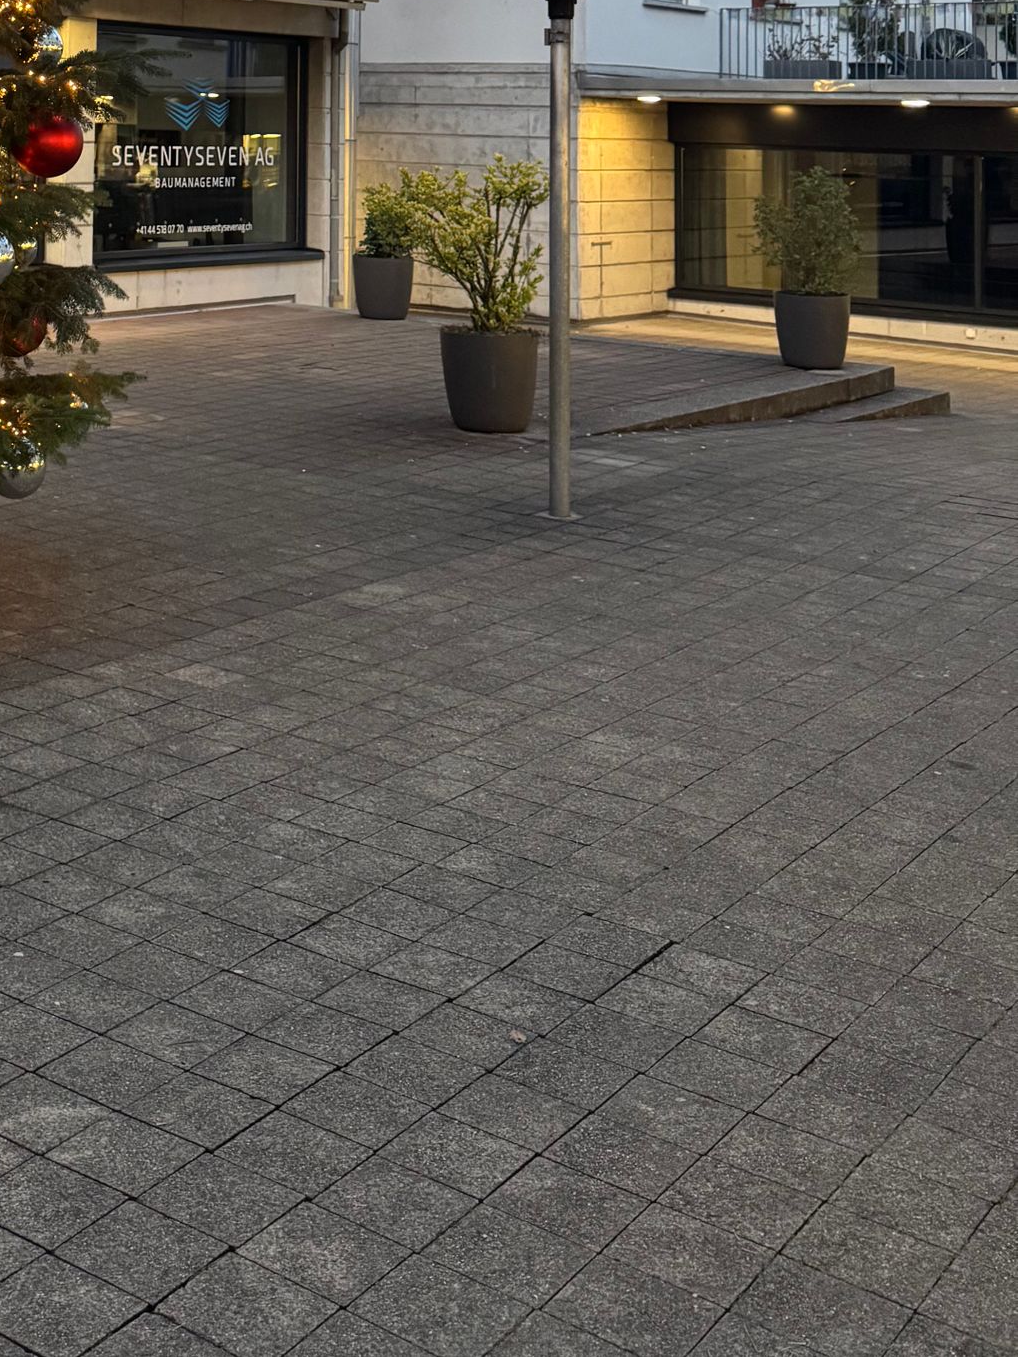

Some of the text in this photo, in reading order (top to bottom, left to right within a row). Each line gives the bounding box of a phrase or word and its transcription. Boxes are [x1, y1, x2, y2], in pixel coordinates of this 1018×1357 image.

[112, 145, 274, 167] SEVENTYSEVEN AG
[155, 177, 236, 188] BAUMANAGEMENT
[136, 225, 147, 234] +41
[147, 225, 156, 234] 44
[167, 224, 175, 234] 07
[176, 224, 184, 233] 70
